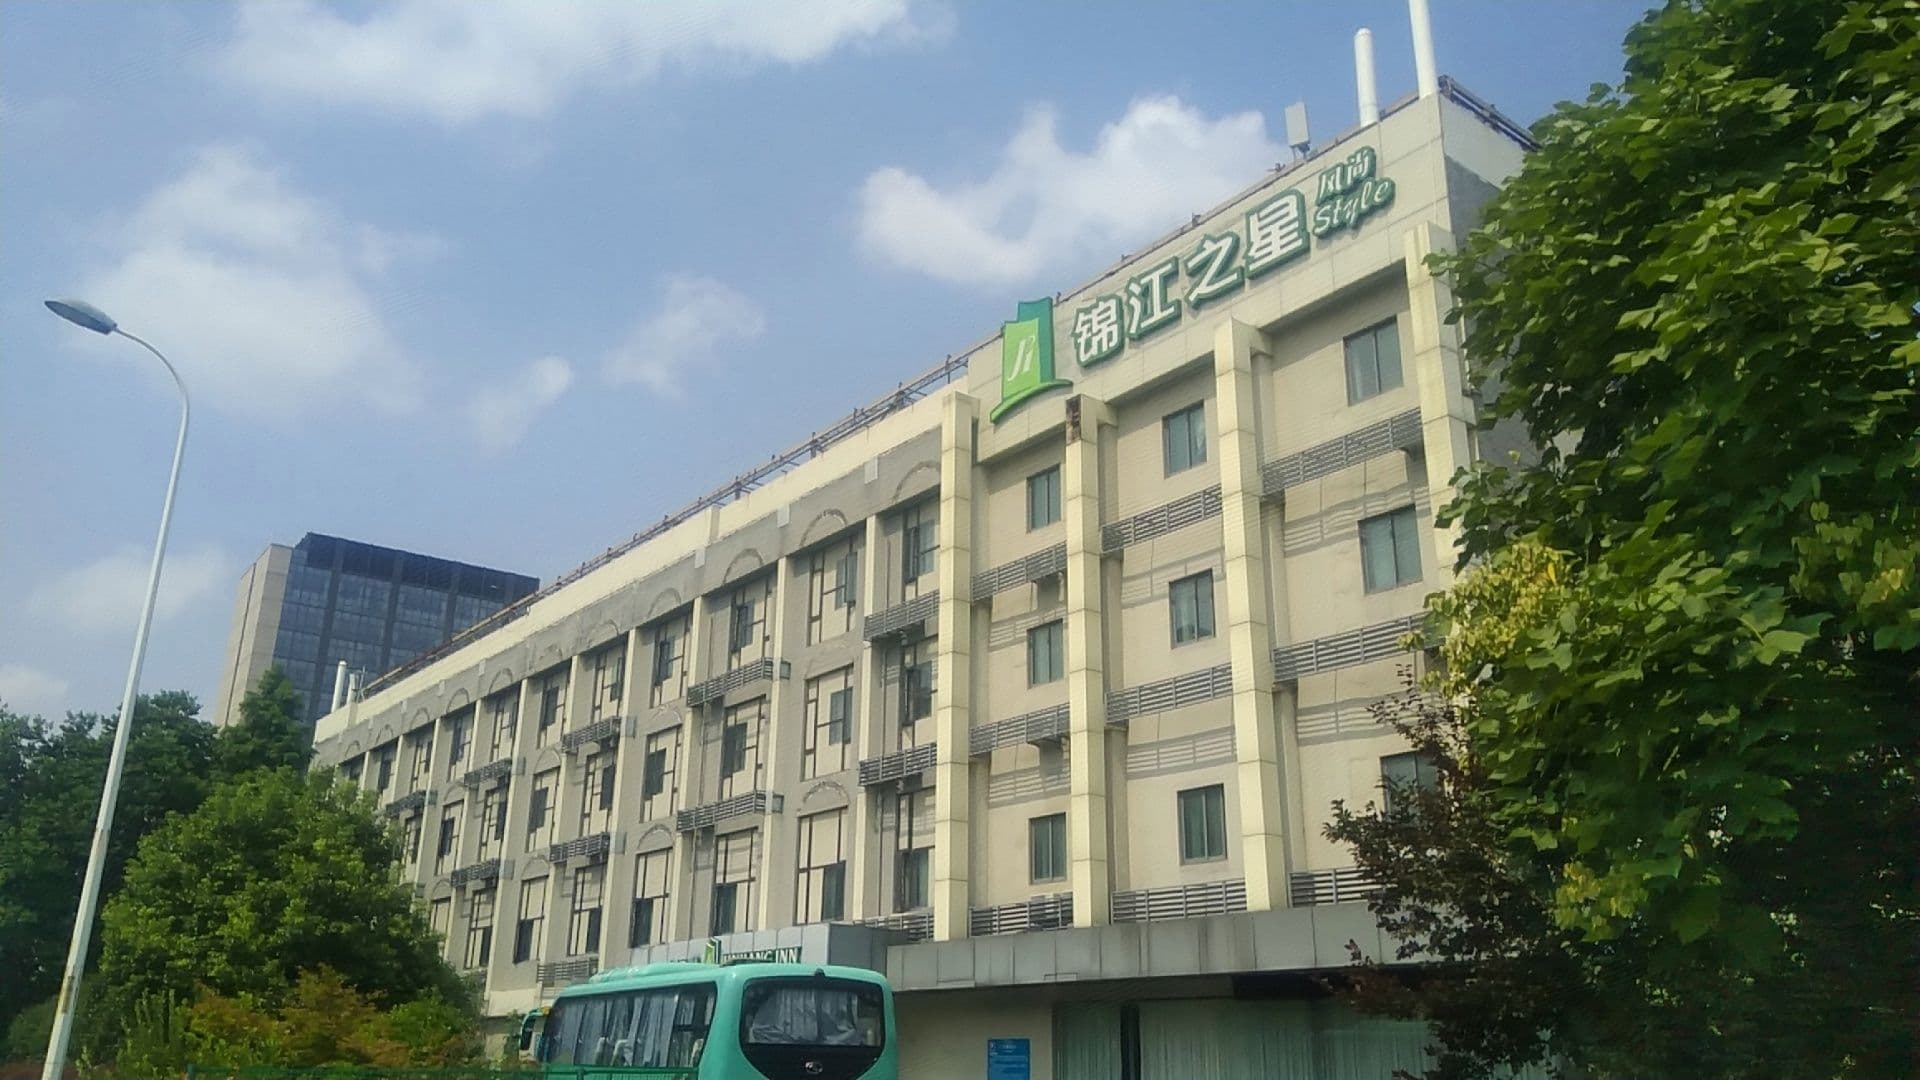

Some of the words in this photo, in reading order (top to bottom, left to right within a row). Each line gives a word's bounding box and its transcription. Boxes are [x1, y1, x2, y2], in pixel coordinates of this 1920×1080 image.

[1319, 150, 1370, 198] 风尚
[1313, 180, 1390, 234] Style
[1074, 193, 1304, 363] 锦江之星
[775, 947, 799, 963] INN
